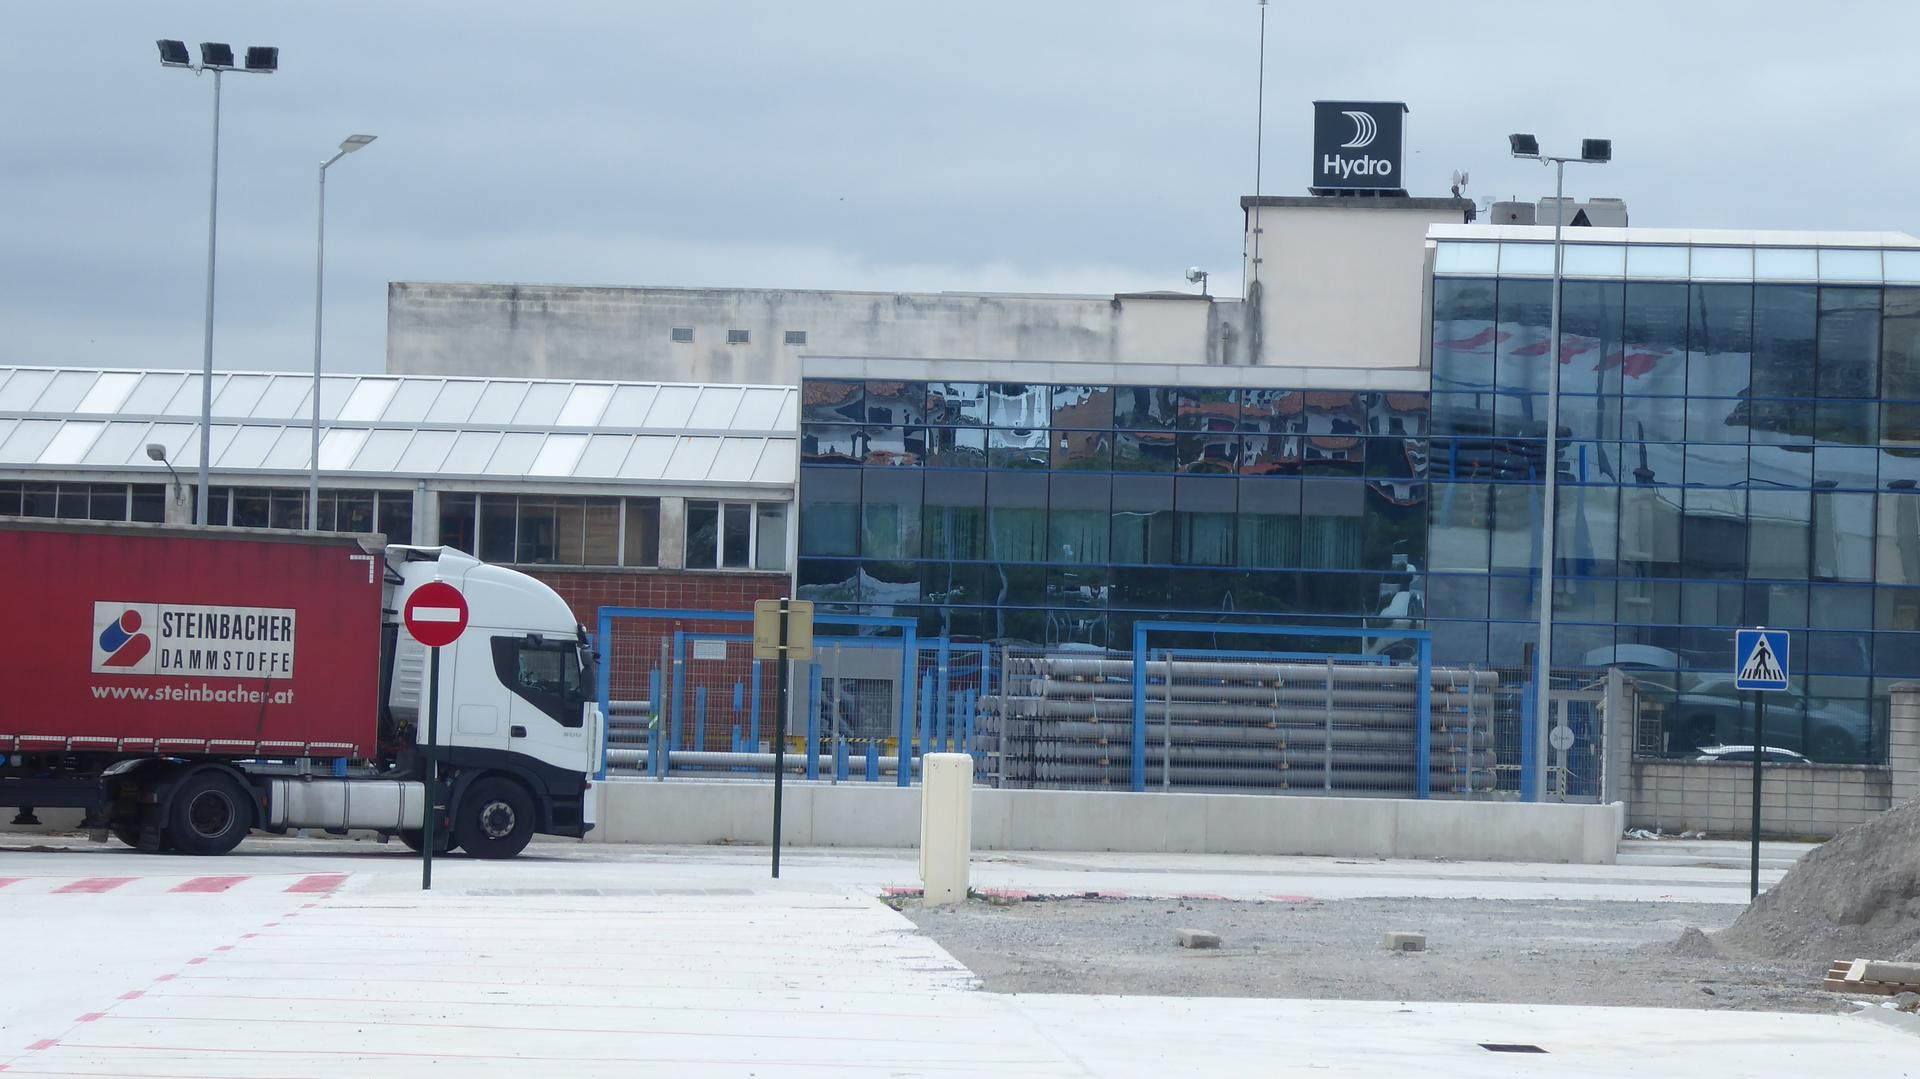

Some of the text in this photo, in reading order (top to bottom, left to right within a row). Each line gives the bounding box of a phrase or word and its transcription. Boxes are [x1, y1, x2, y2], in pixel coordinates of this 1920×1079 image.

[1323, 154, 1392, 179] Hydro
[162, 611, 292, 642] STEINBACHER
[161, 648, 290, 672] DAMMSTOFFE
[91, 683, 294, 704] www.steinbacher.at
